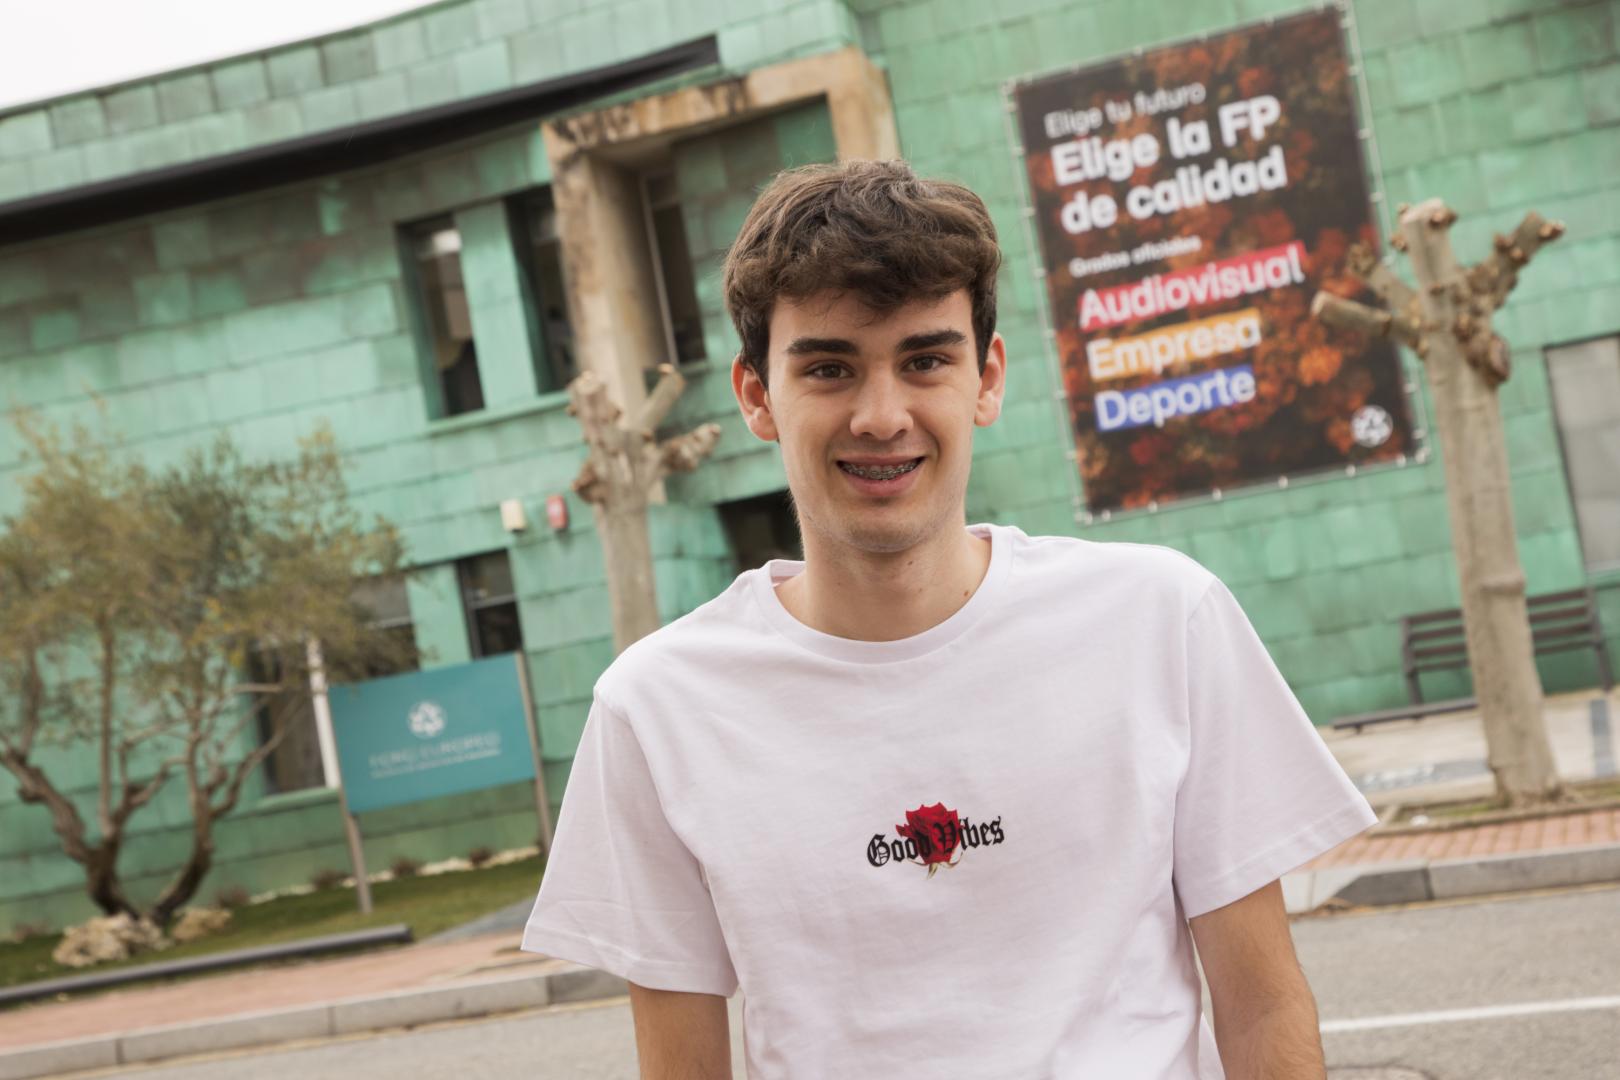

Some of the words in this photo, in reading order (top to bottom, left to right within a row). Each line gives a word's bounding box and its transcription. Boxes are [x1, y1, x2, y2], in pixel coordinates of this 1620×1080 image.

[1044, 108, 1102, 138] Elige
[1105, 99, 1132, 124] tu
[1134, 82, 1206, 116] futuro
[1051, 133, 1160, 185] Elige
[1166, 116, 1211, 159] la
[1218, 95, 1281, 147] FP
[1060, 190, 1118, 234] de
[1126, 145, 1287, 220] calidad
[1080, 244, 1305, 329] Audiovisual
[1086, 316, 1262, 381] Empresa
[1095, 369, 1256, 430] Deporte
[867, 829, 933, 867] Good
[934, 816, 1005, 854] Vibes
